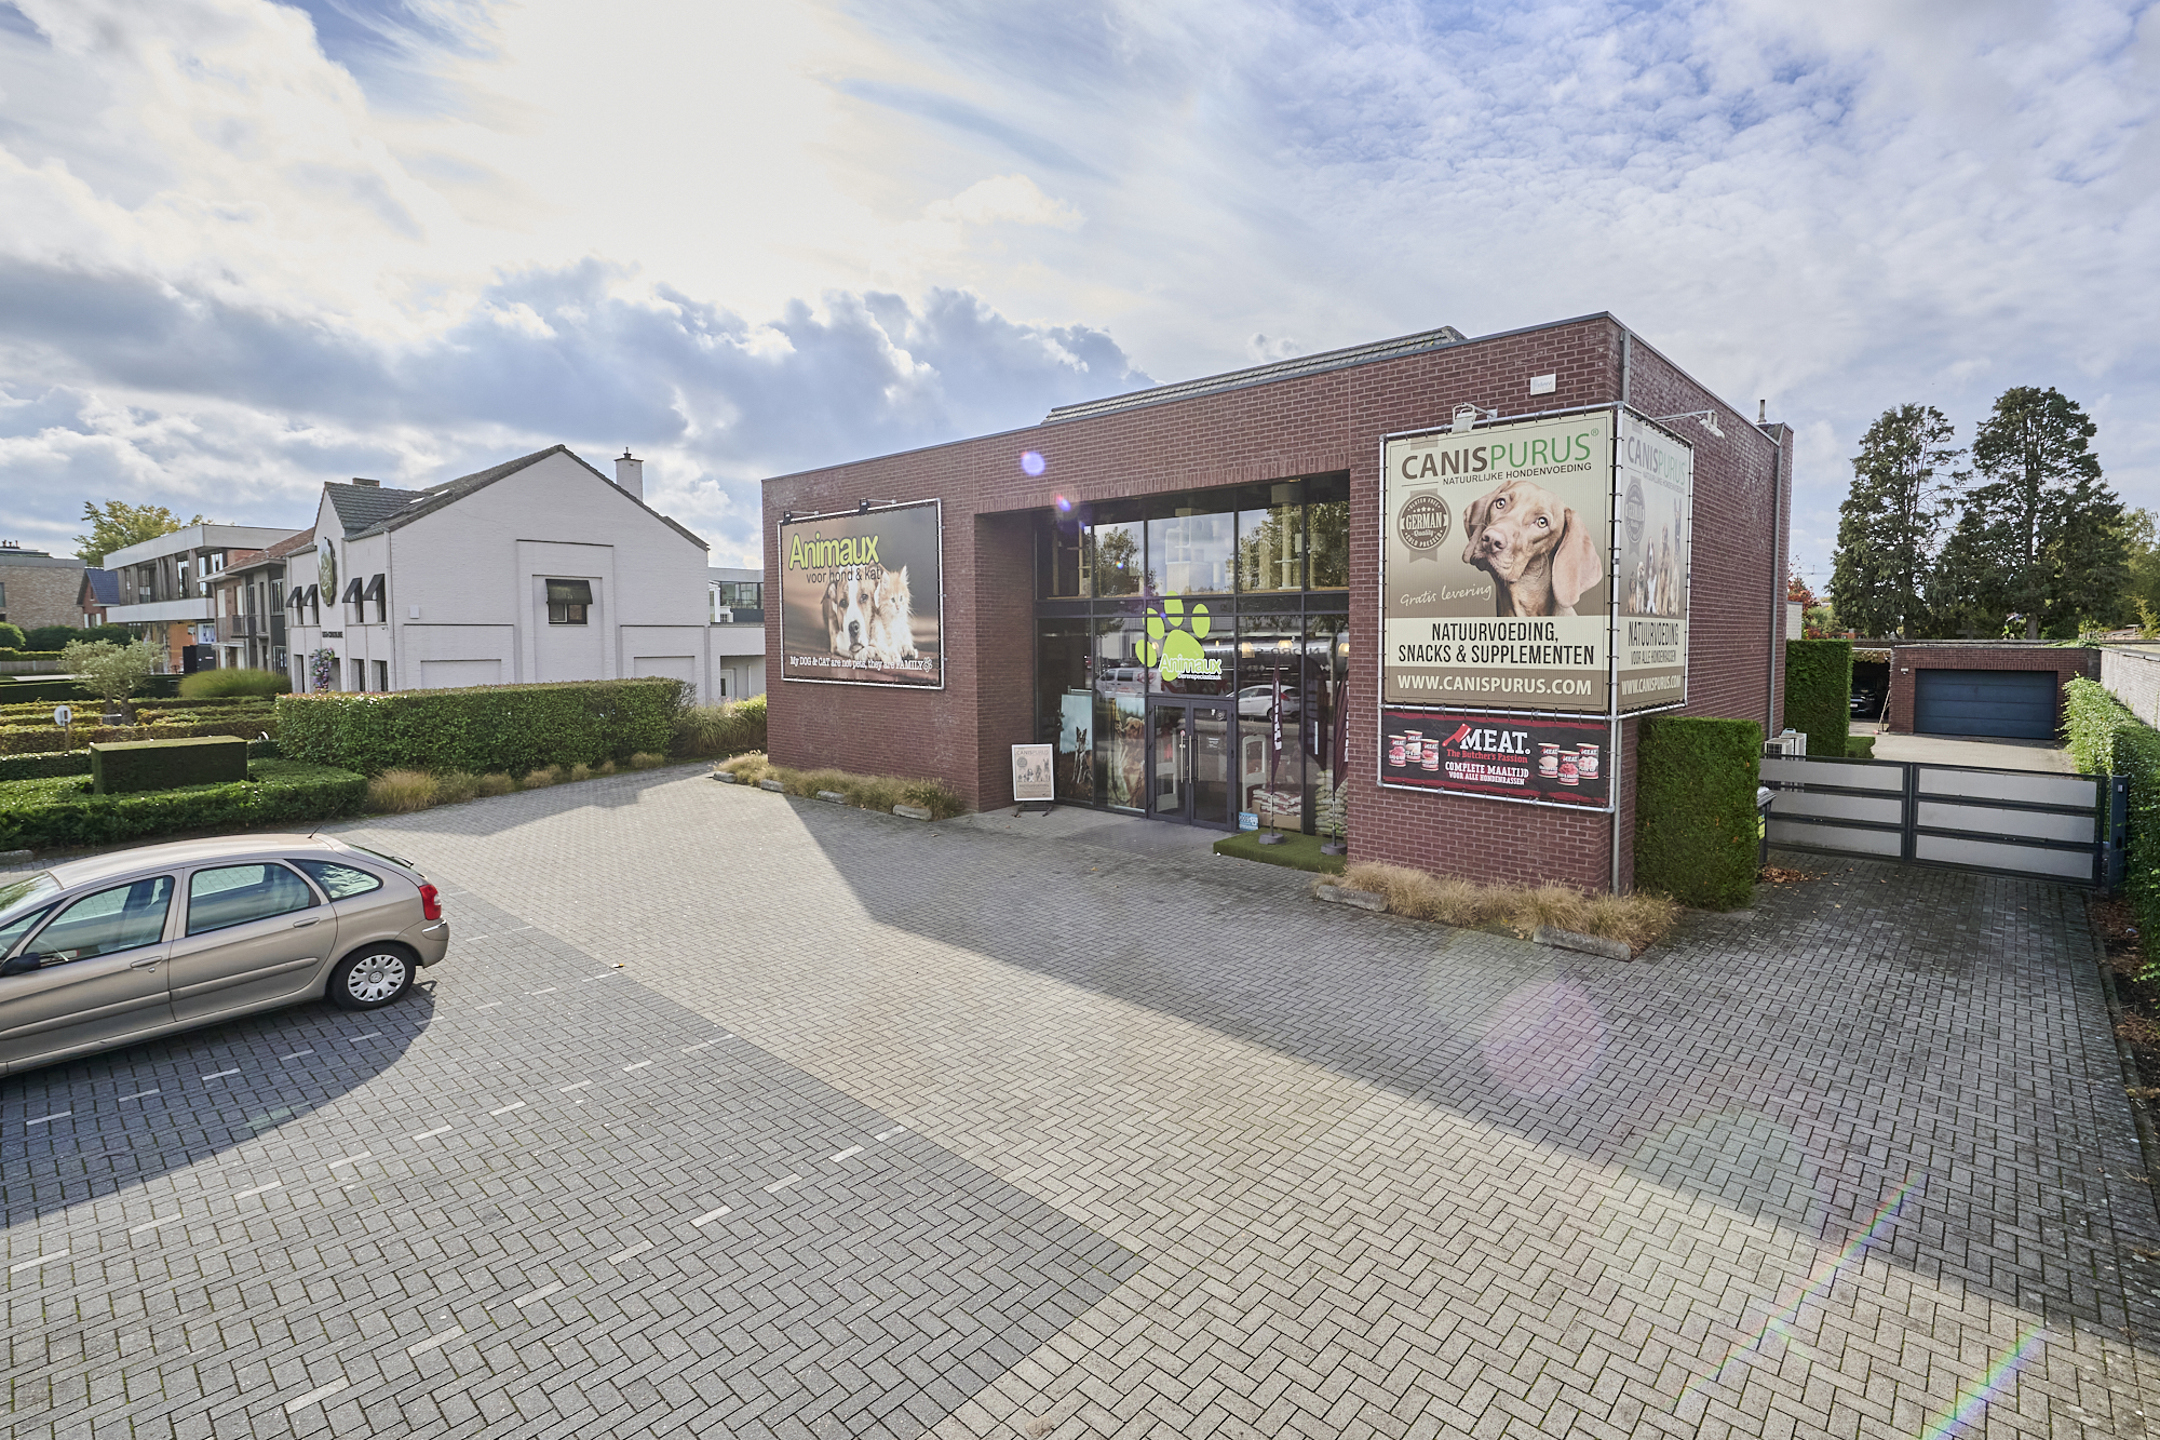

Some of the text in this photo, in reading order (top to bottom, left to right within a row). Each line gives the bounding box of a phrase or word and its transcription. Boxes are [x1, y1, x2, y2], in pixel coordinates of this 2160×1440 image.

[1627, 436, 1686, 486] CANISPURUS
[1442, 462, 1592, 486] NATUURLIJKE HONDENVOEDING
[1406, 511, 1442, 530] GERMAN
[788, 531, 880, 571] Animaux
[806, 566, 881, 584] voor hond & kat
[1400, 583, 1492, 607] Gratis levering
[1431, 622, 1559, 643] NATUURVOEDING,
[1628, 621, 1679, 647] NATUURVOEDING
[790, 656, 800, 667] My
[800, 656, 812, 666] DOG
[819, 657, 831, 667] CAT
[1159, 653, 1223, 674] Animaux
[1398, 644, 1595, 665] SNACKS & SUPPLEMENTEN
[1397, 674, 1592, 696] WWW.CANISPURUS.COM
[1446, 748, 1528, 763] The Butcher's Passion
[1445, 761, 1529, 778] COMPLETE MAALTIJD
[1448, 771, 1525, 785] VOOR ALLE HONDENRASSEN
